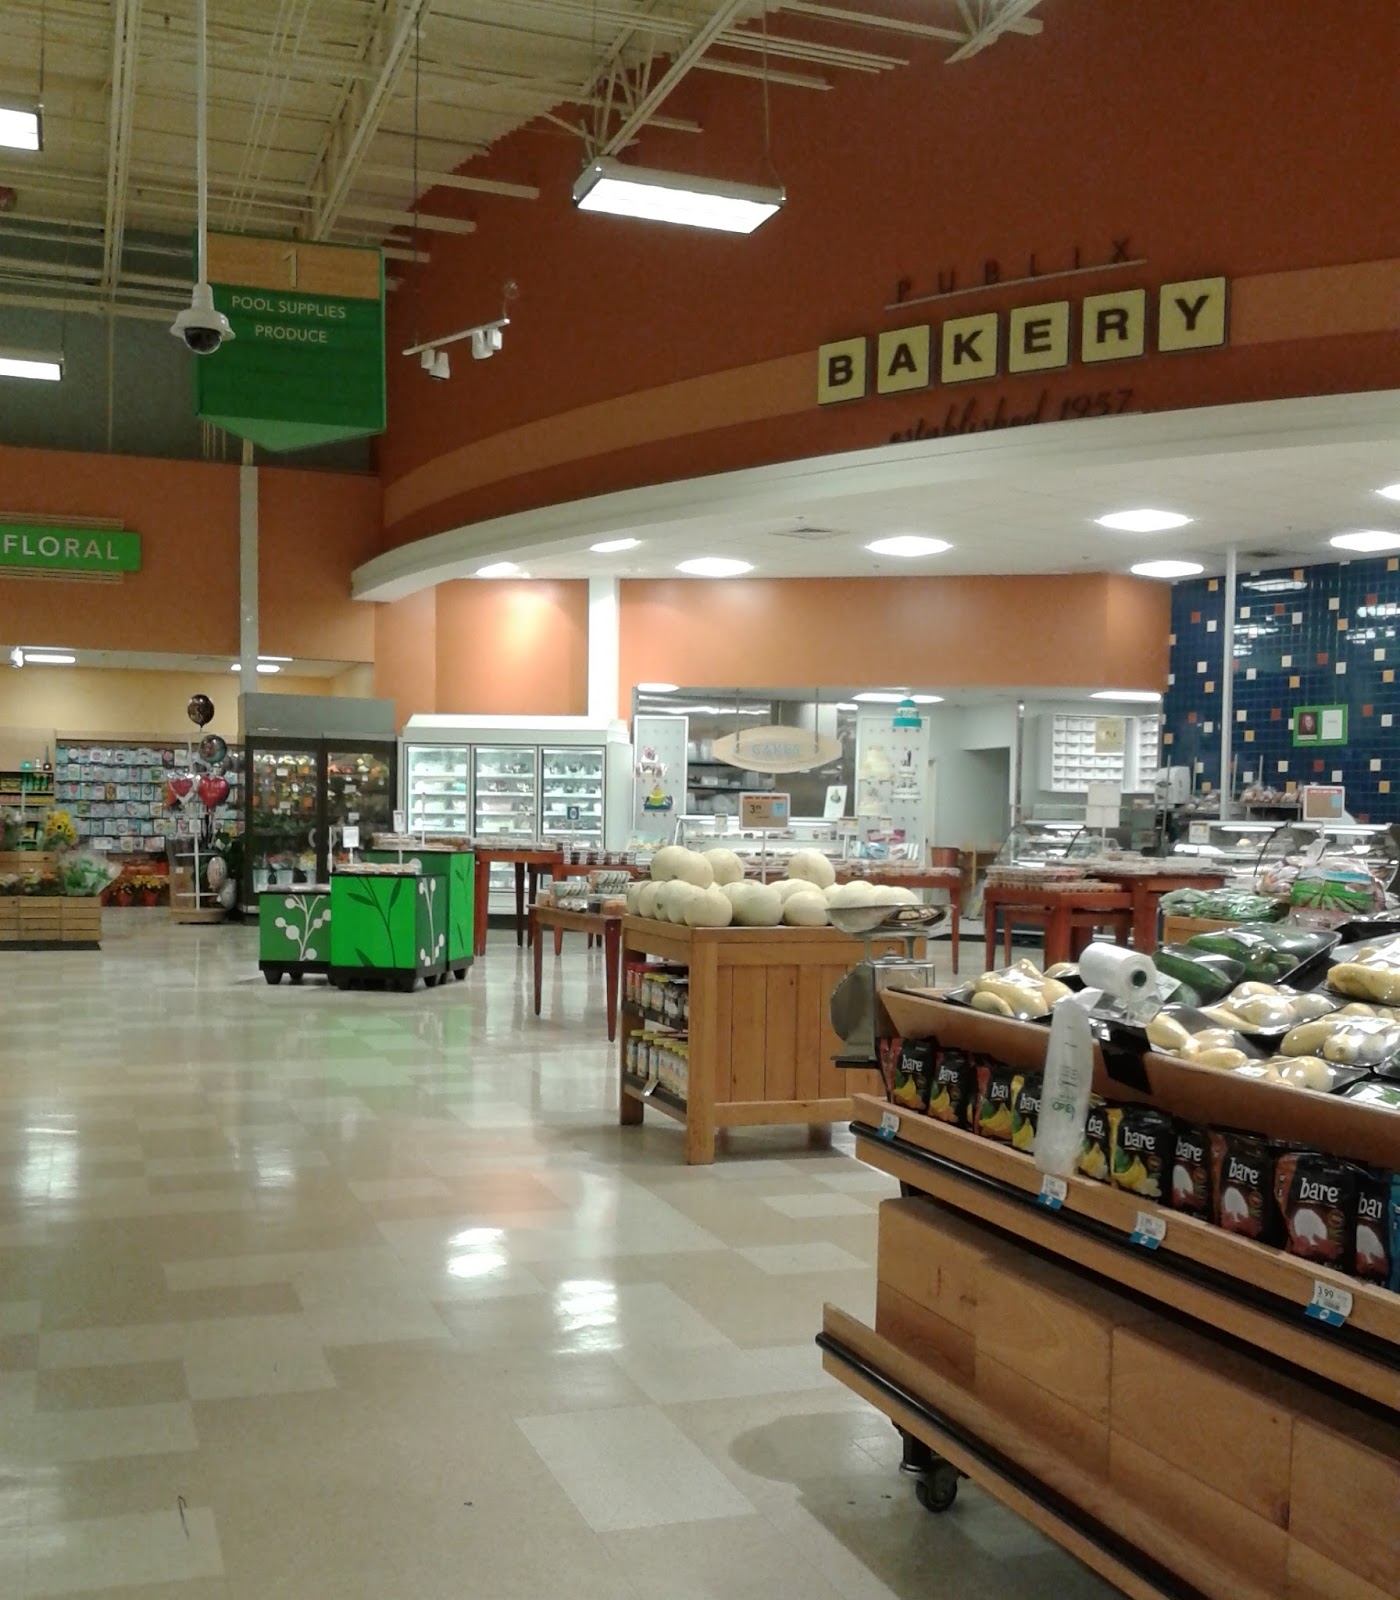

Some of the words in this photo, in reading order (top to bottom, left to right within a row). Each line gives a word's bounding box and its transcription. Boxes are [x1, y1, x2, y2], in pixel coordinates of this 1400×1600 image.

[283, 249, 297, 289] 1
[896, 238, 1130, 304] PUBLIX
[231, 295, 275, 312] POOL
[278, 300, 346, 319] SUPPLIES
[255, 324, 328, 344] PRODUCE
[827, 294, 1210, 388] BAKERY
[3, 533, 120, 560] FLORAL
[901, 1054, 923, 1073] bare
[938, 1065, 959, 1083] bare
[1123, 1126, 1156, 1151] bare
[1174, 1136, 1203, 1162] bare
[1228, 1156, 1259, 1185] bare
[1299, 1176, 1340, 1204] bare
